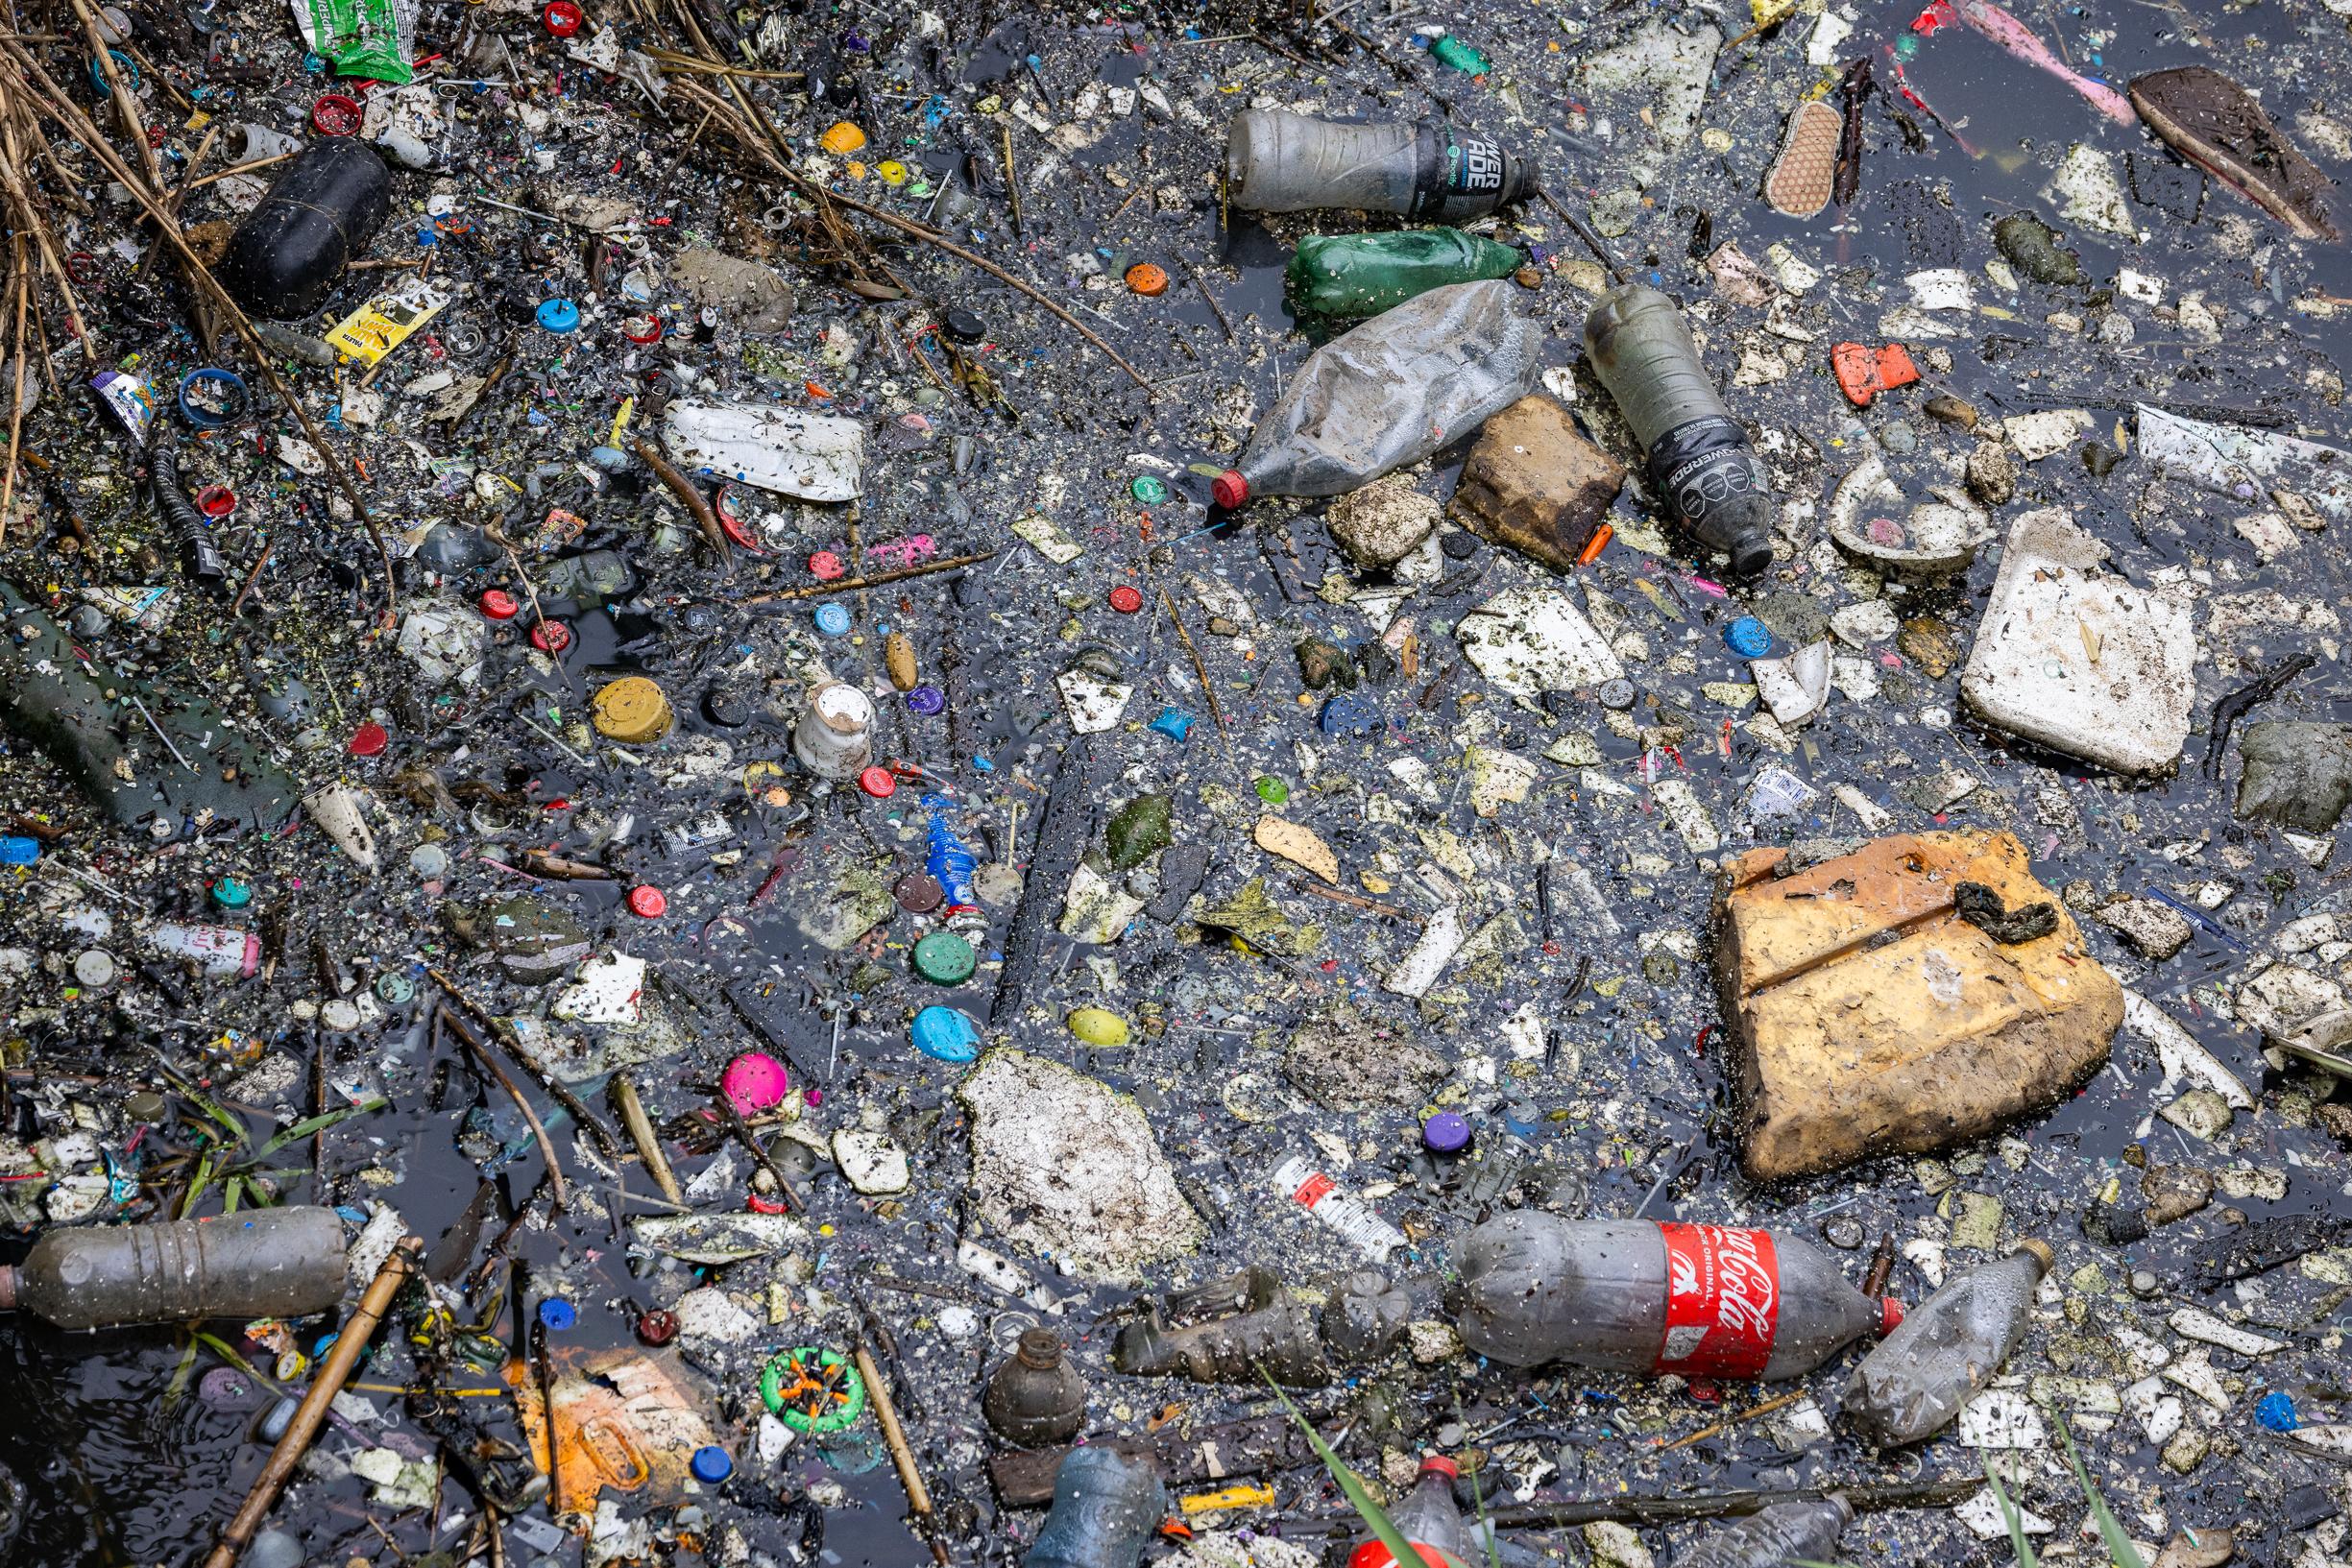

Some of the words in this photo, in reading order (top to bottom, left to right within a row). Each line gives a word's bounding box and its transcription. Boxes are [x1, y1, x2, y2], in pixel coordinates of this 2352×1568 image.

[1447, 158, 1458, 187] Spotify
[1467, 138, 1488, 188] ADE
[1480, 131, 1502, 189] OWER
[341, 333, 363, 348] PALETA
[1704, 1247, 1714, 1300] ORIGINAL
[1718, 1227, 1773, 1343] ca-Cola
